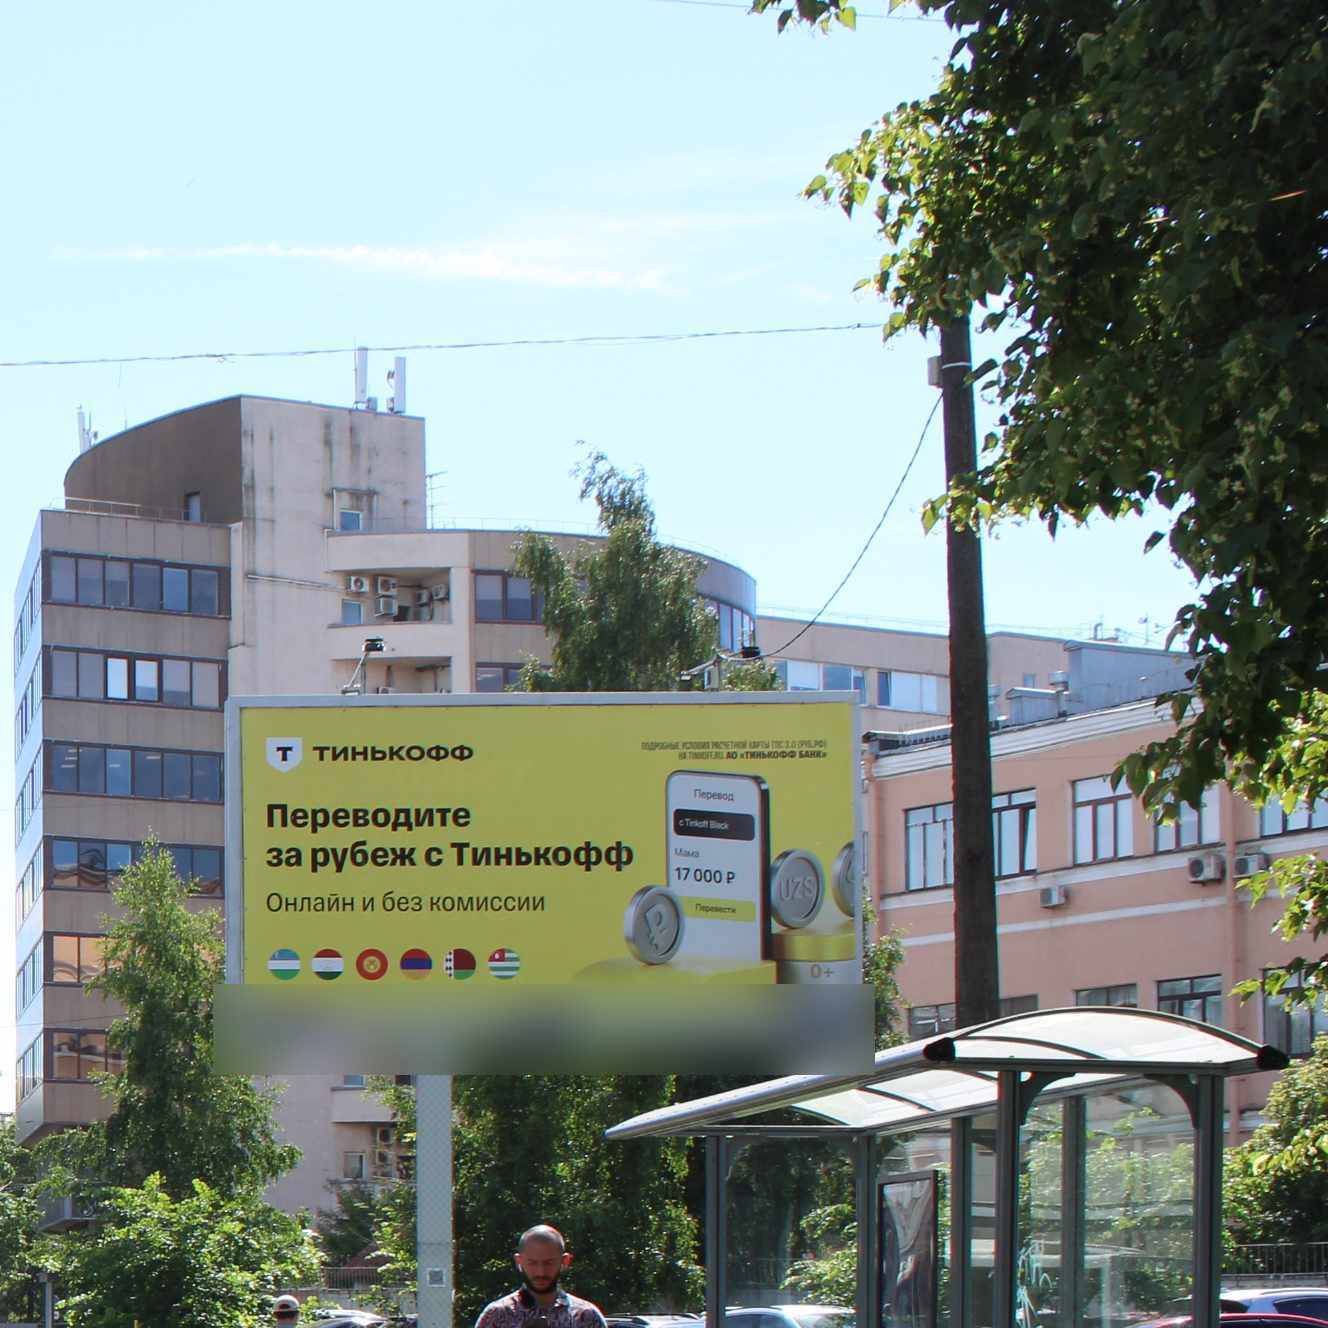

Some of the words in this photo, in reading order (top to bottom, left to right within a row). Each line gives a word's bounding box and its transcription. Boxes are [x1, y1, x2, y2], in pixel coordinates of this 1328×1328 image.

[312, 745, 474, 761] ТИНЬКОФФ
[694, 788, 735, 801] Перевод
[266, 803, 472, 834] Переводите
[266, 846, 302, 868] за
[311, 840, 417, 873] рубеж
[424, 846, 444, 868] с
[450, 841, 634, 872] Тинькофф
[675, 867, 691, 881] 17
[693, 868, 723, 884] 000
[266, 892, 354, 912] Онлайн
[362, 896, 375, 912] и
[382, 890, 423, 912] без
[430, 896, 545, 912] комиссии
